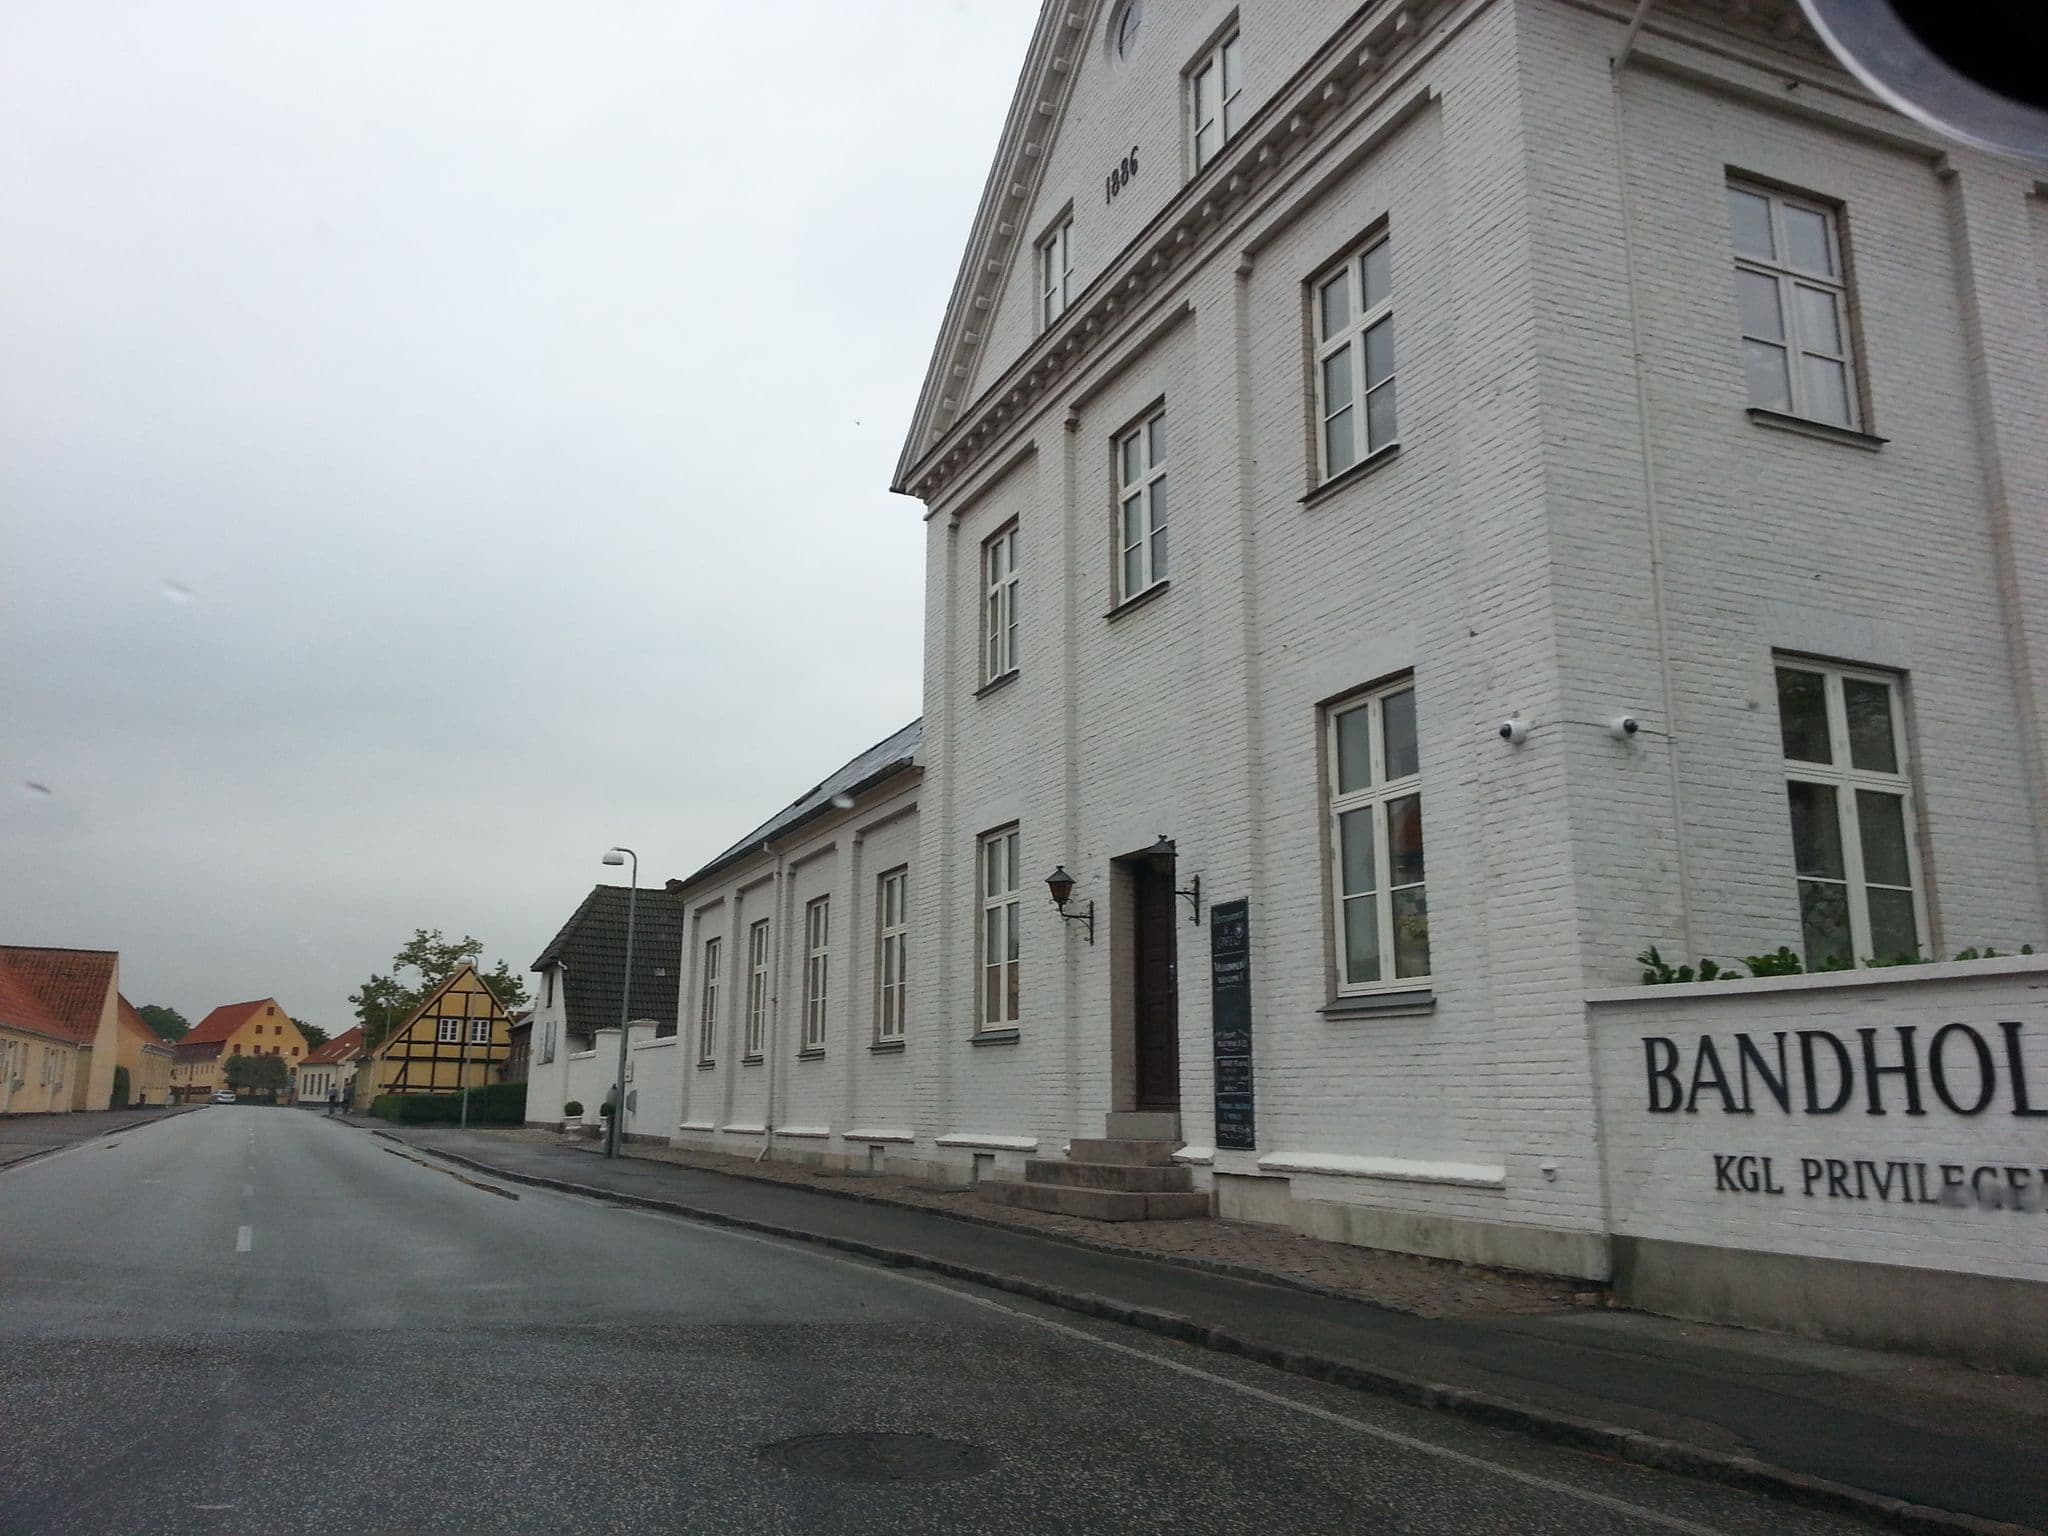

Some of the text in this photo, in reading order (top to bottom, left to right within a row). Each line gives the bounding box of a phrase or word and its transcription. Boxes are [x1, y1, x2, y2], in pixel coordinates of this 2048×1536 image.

[1106, 145, 1139, 205] 1886
[1642, 1021, 2048, 1115] BANDHOL
[1713, 1154, 2048, 1213] KGL PRIVILEGE
